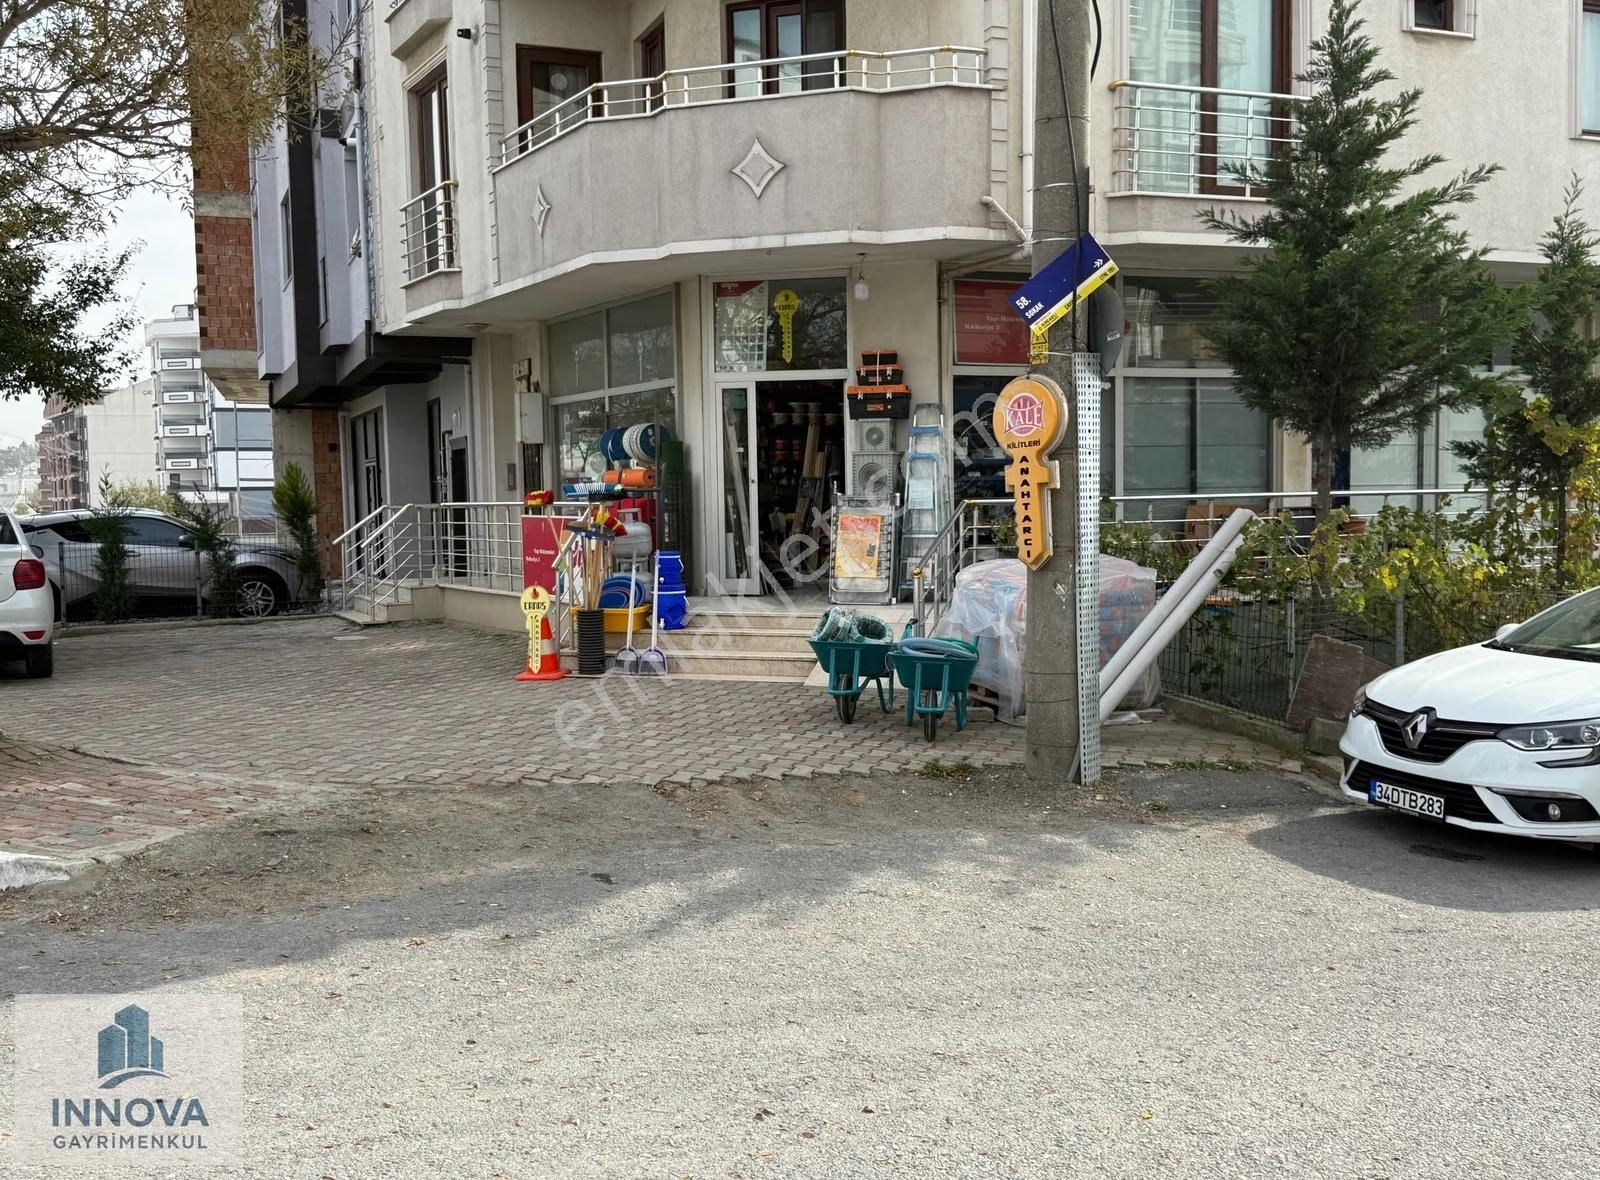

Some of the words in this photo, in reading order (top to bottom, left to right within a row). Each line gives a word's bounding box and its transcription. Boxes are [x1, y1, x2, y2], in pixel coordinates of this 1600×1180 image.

[1015, 296, 1031, 310] 58.
[1025, 301, 1044, 319] SOKAK
[1005, 403, 1043, 432] KALE
[1006, 439, 1041, 450] KİLİTLERİ
[1019, 455, 1033, 558] ANAHTARCI
[1376, 784, 1443, 816] 34DTB283
